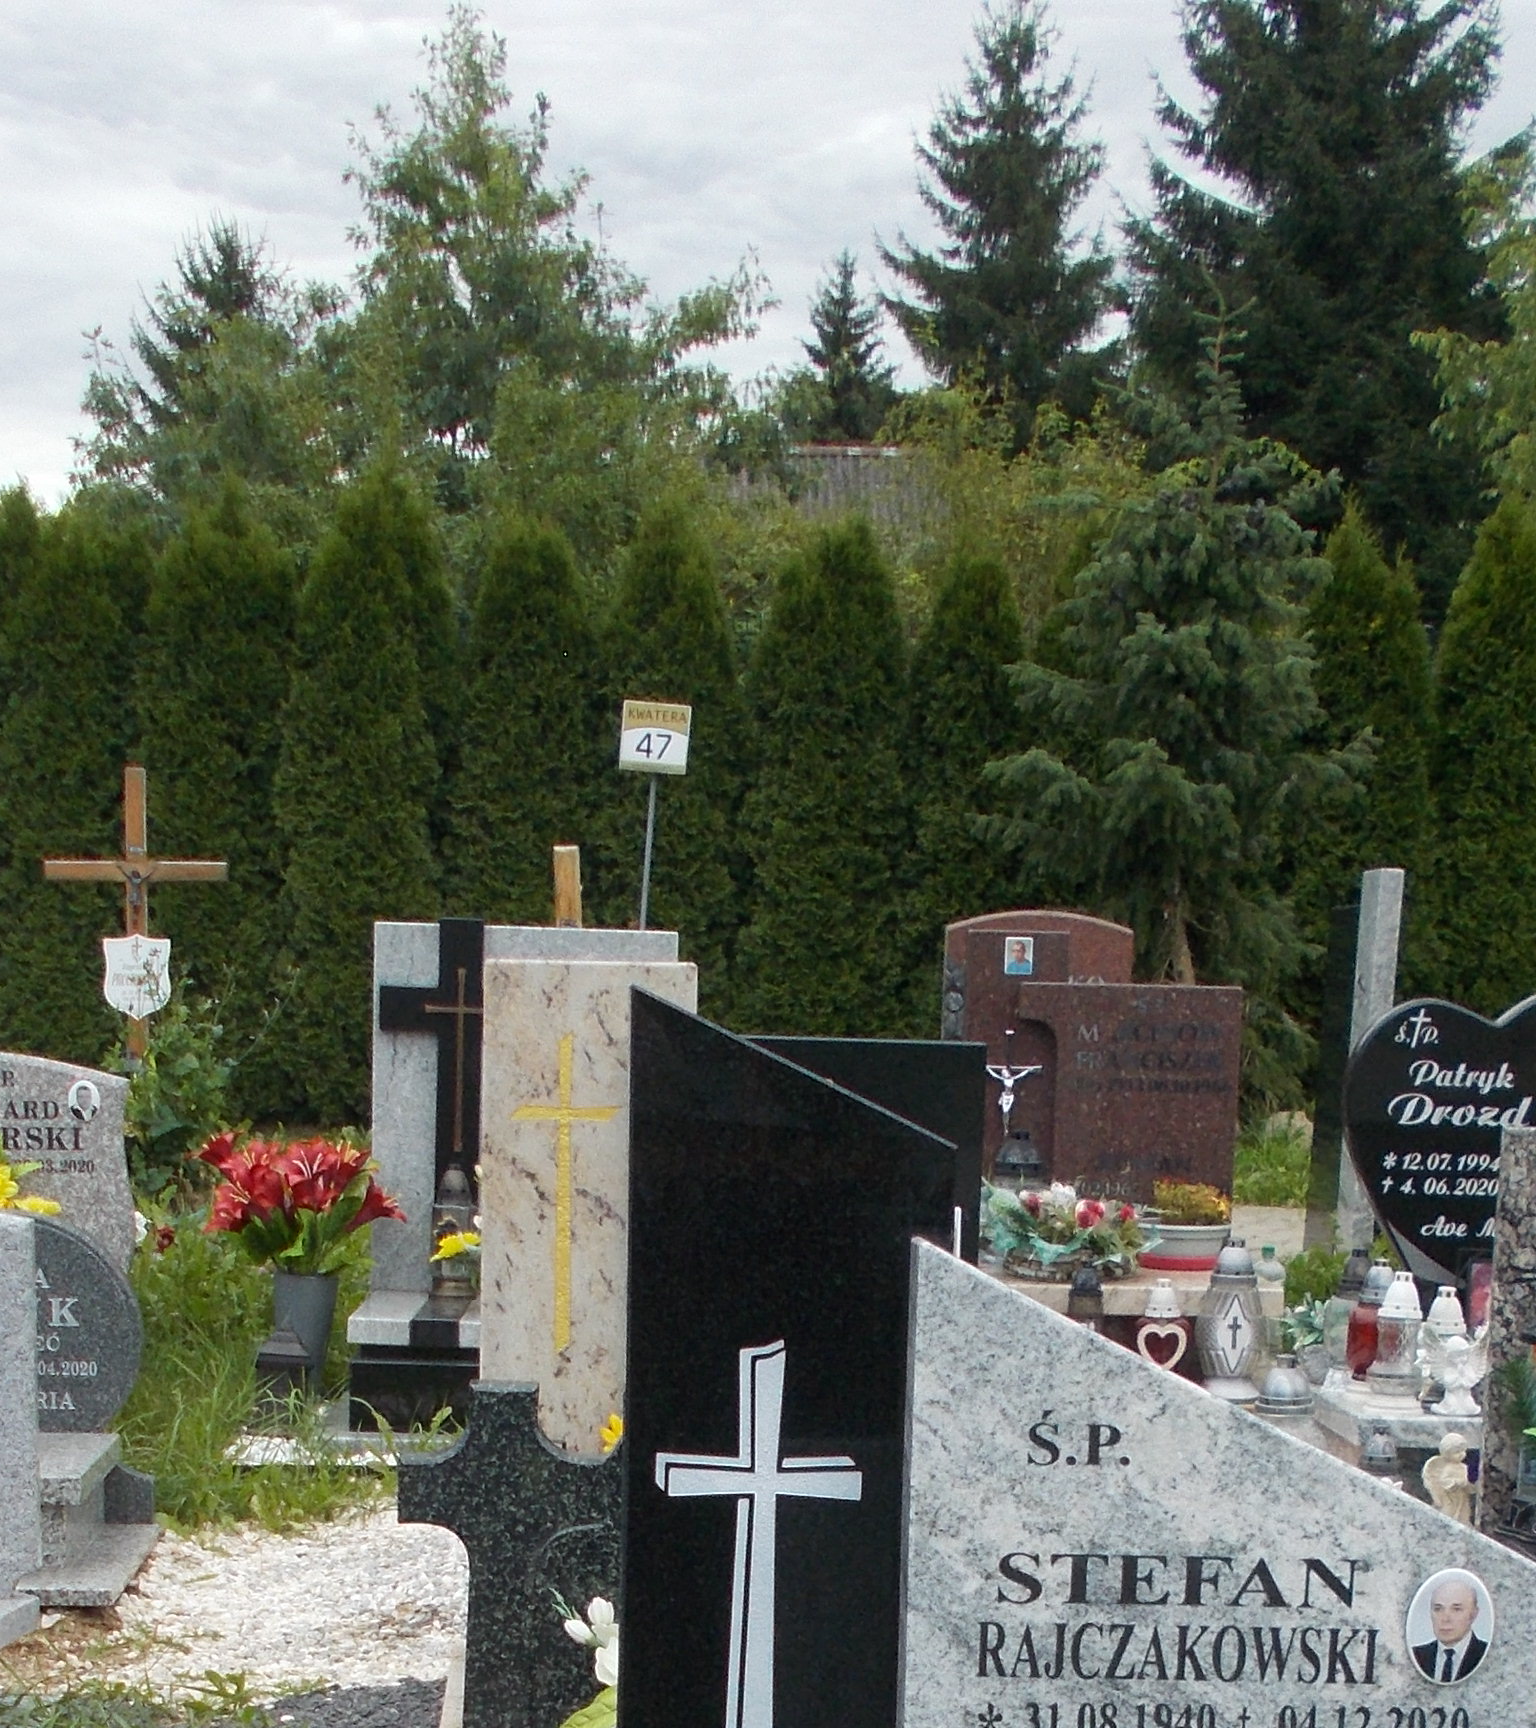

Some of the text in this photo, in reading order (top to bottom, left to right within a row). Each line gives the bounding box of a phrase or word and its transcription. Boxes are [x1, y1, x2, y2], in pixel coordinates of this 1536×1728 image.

[628, 707, 687, 724] KWATERA
[635, 733, 672, 760] 47
[1410, 1059, 1515, 1095] Patryk
[1388, 1093, 1532, 1127] Drozd
[1421, 1215, 1467, 1237] Ave
[38, 1361, 98, 1377] 04.2020
[37, 1391, 76, 1410] RIA
[1027, 1410, 1131, 1466] Ś.P.
[996, 1552, 1364, 1608] STEFAN
[976, 1621, 1380, 1685] RAJCZAKOWSKI
